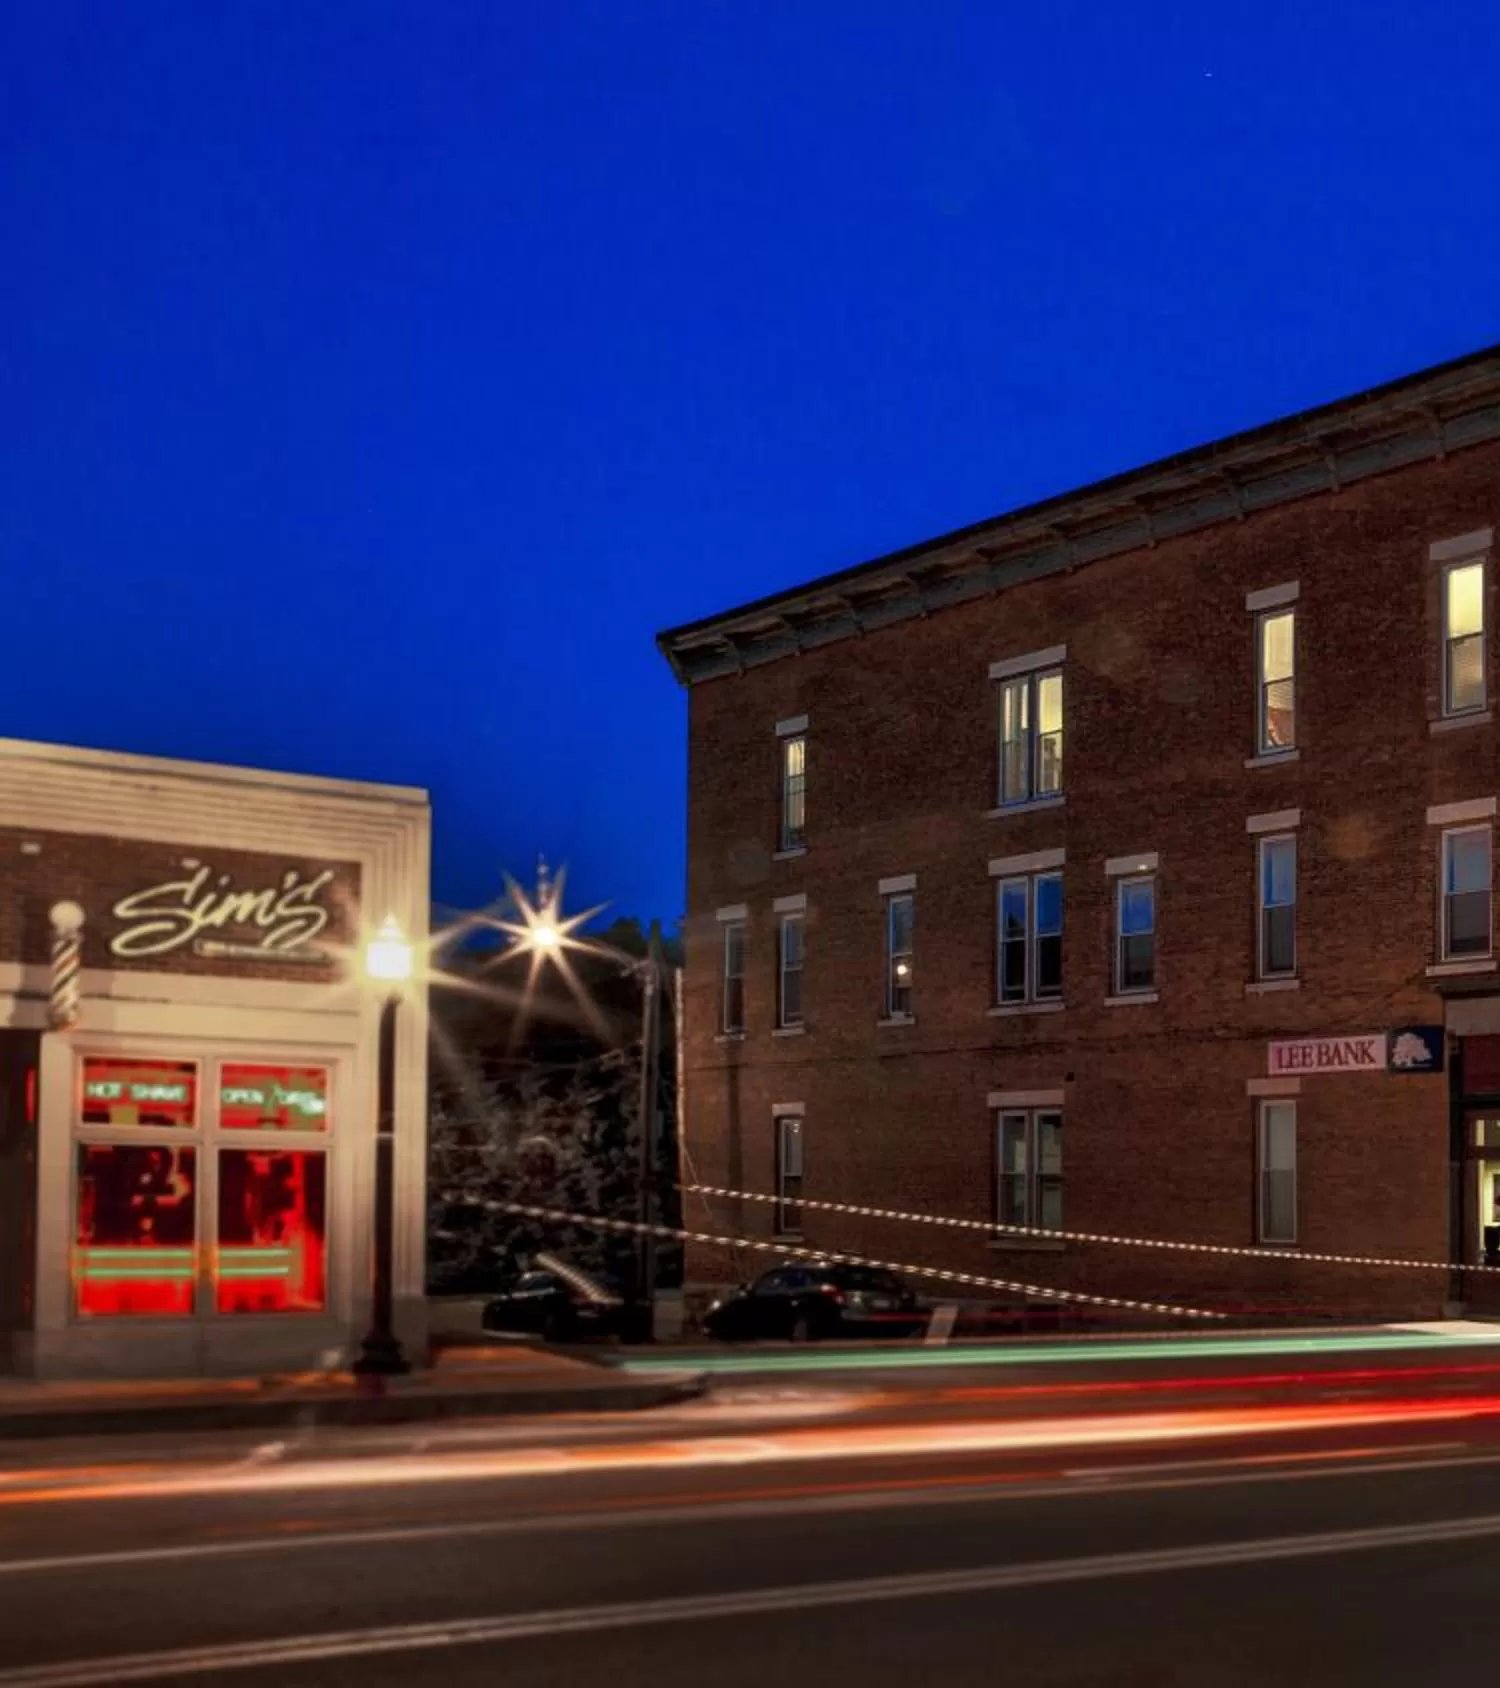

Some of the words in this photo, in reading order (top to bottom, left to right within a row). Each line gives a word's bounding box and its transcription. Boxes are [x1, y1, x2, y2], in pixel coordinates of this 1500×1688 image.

[111, 865, 335, 956] Sim's
[1277, 1044, 1314, 1069] LEE
[1317, 1040, 1376, 1067] BANK
